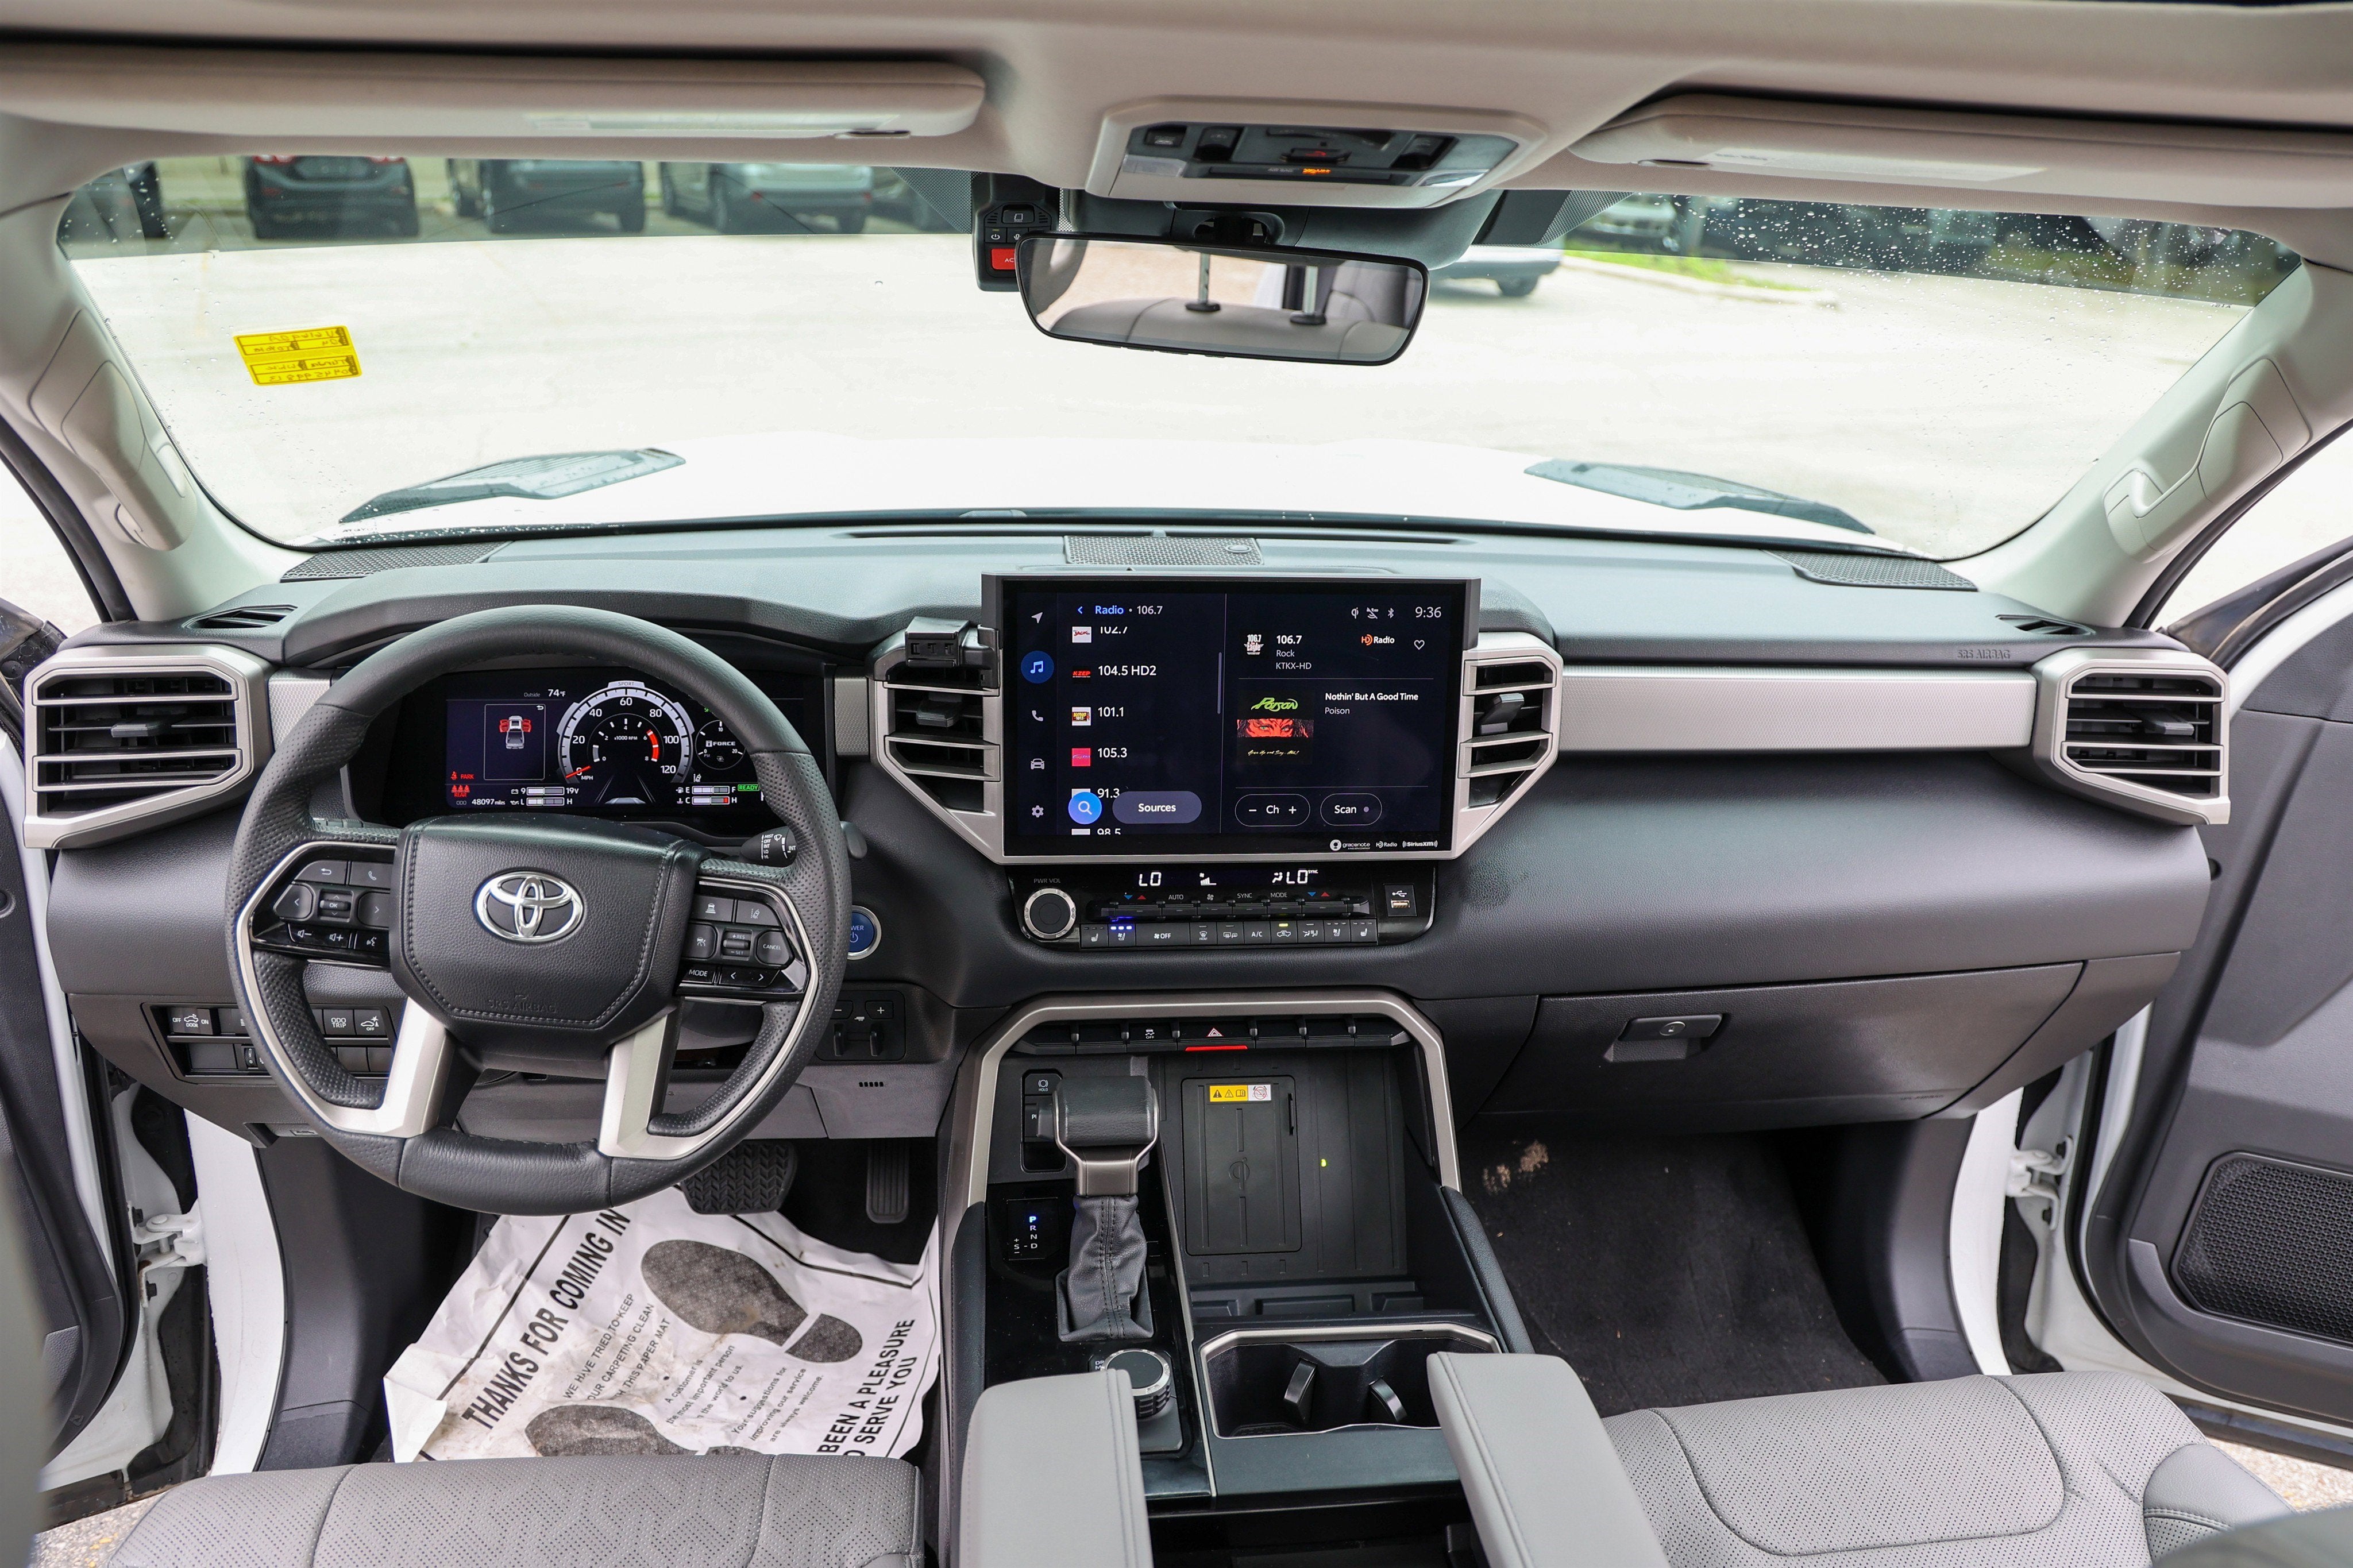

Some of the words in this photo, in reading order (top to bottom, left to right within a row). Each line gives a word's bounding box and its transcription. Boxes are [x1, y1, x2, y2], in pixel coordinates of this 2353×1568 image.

[1095, 605, 1124, 615] Radio
[1136, 605, 1163, 615] 106.7
[1415, 607, 1442, 619] 9:36
[1276, 635, 1302, 644] 106.7
[1374, 636, 1395, 644] Radio
[1276, 650, 1295, 658] Rock
[1098, 665, 1128, 675] 104.5
[1131, 665, 1156, 675] HD2
[1325, 693, 1353, 701] Nothin'
[1376, 693, 1399, 701] Good
[1400, 693, 1418, 701] Time
[589, 709, 602, 717] 40
[1098, 706, 1124, 717] 101.1
[572, 736, 585, 744] 20
[664, 736, 680, 744] 100
[1097, 748, 1127, 758] 105.3
[660, 765, 676, 774] 120
[1097, 788, 1120, 798] 91.3
[1138, 803, 1176, 812] Sources
[1266, 805, 1279, 814] Ch
[1334, 805, 1357, 814] Scan
[1139, 871, 1161, 886] LO
[1286, 870, 1308, 884] LO
[689, 969, 708, 977] MODE
[462, 1351, 539, 1430] THANKS
[519, 1307, 569, 1356] FOR
[549, 1232, 614, 1310] COMING
[595, 1208, 631, 1237] IN
[563, 1383, 579, 1399] WE
[575, 1360, 596, 1383] HAVE
[591, 1333, 612, 1358] TRIED
[608, 1319, 620, 1332] TO
[616, 1293, 634, 1318] KEEP
[601, 1335, 636, 1382] CARPETING
[632, 1303, 654, 1334] CLEAN
[623, 1370, 640, 1388] THIS
[637, 1340, 659, 1370] PAPER
[655, 1318, 670, 1339] MAT
[856, 1319, 916, 1394] PLEASURE
[672, 1366, 697, 1397] customer
[696, 1359, 703, 1367] is
[666, 1414, 678, 1425] the
[677, 1401, 693, 1416] most
[692, 1368, 718, 1401] important
[715, 1345, 735, 1368] person
[778, 1397, 789, 1408] our
[786, 1368, 807, 1396] service
[700, 1403, 713, 1415] the
[712, 1382, 728, 1401] world
[726, 1375, 735, 1383] to
[731, 1418, 749, 1435] Your
[747, 1377, 780, 1419] suggestions
[776, 1366, 787, 1376] for
[847, 1400, 871, 1409] A
[854, 1395, 900, 1445] SERVE
[885, 1357, 917, 1391] YOU
[770, 1430, 781, 1443] are
[781, 1408, 800, 1429] always
[799, 1374, 824, 1406] welcome.
[816, 1414, 861, 1453] BEEN
